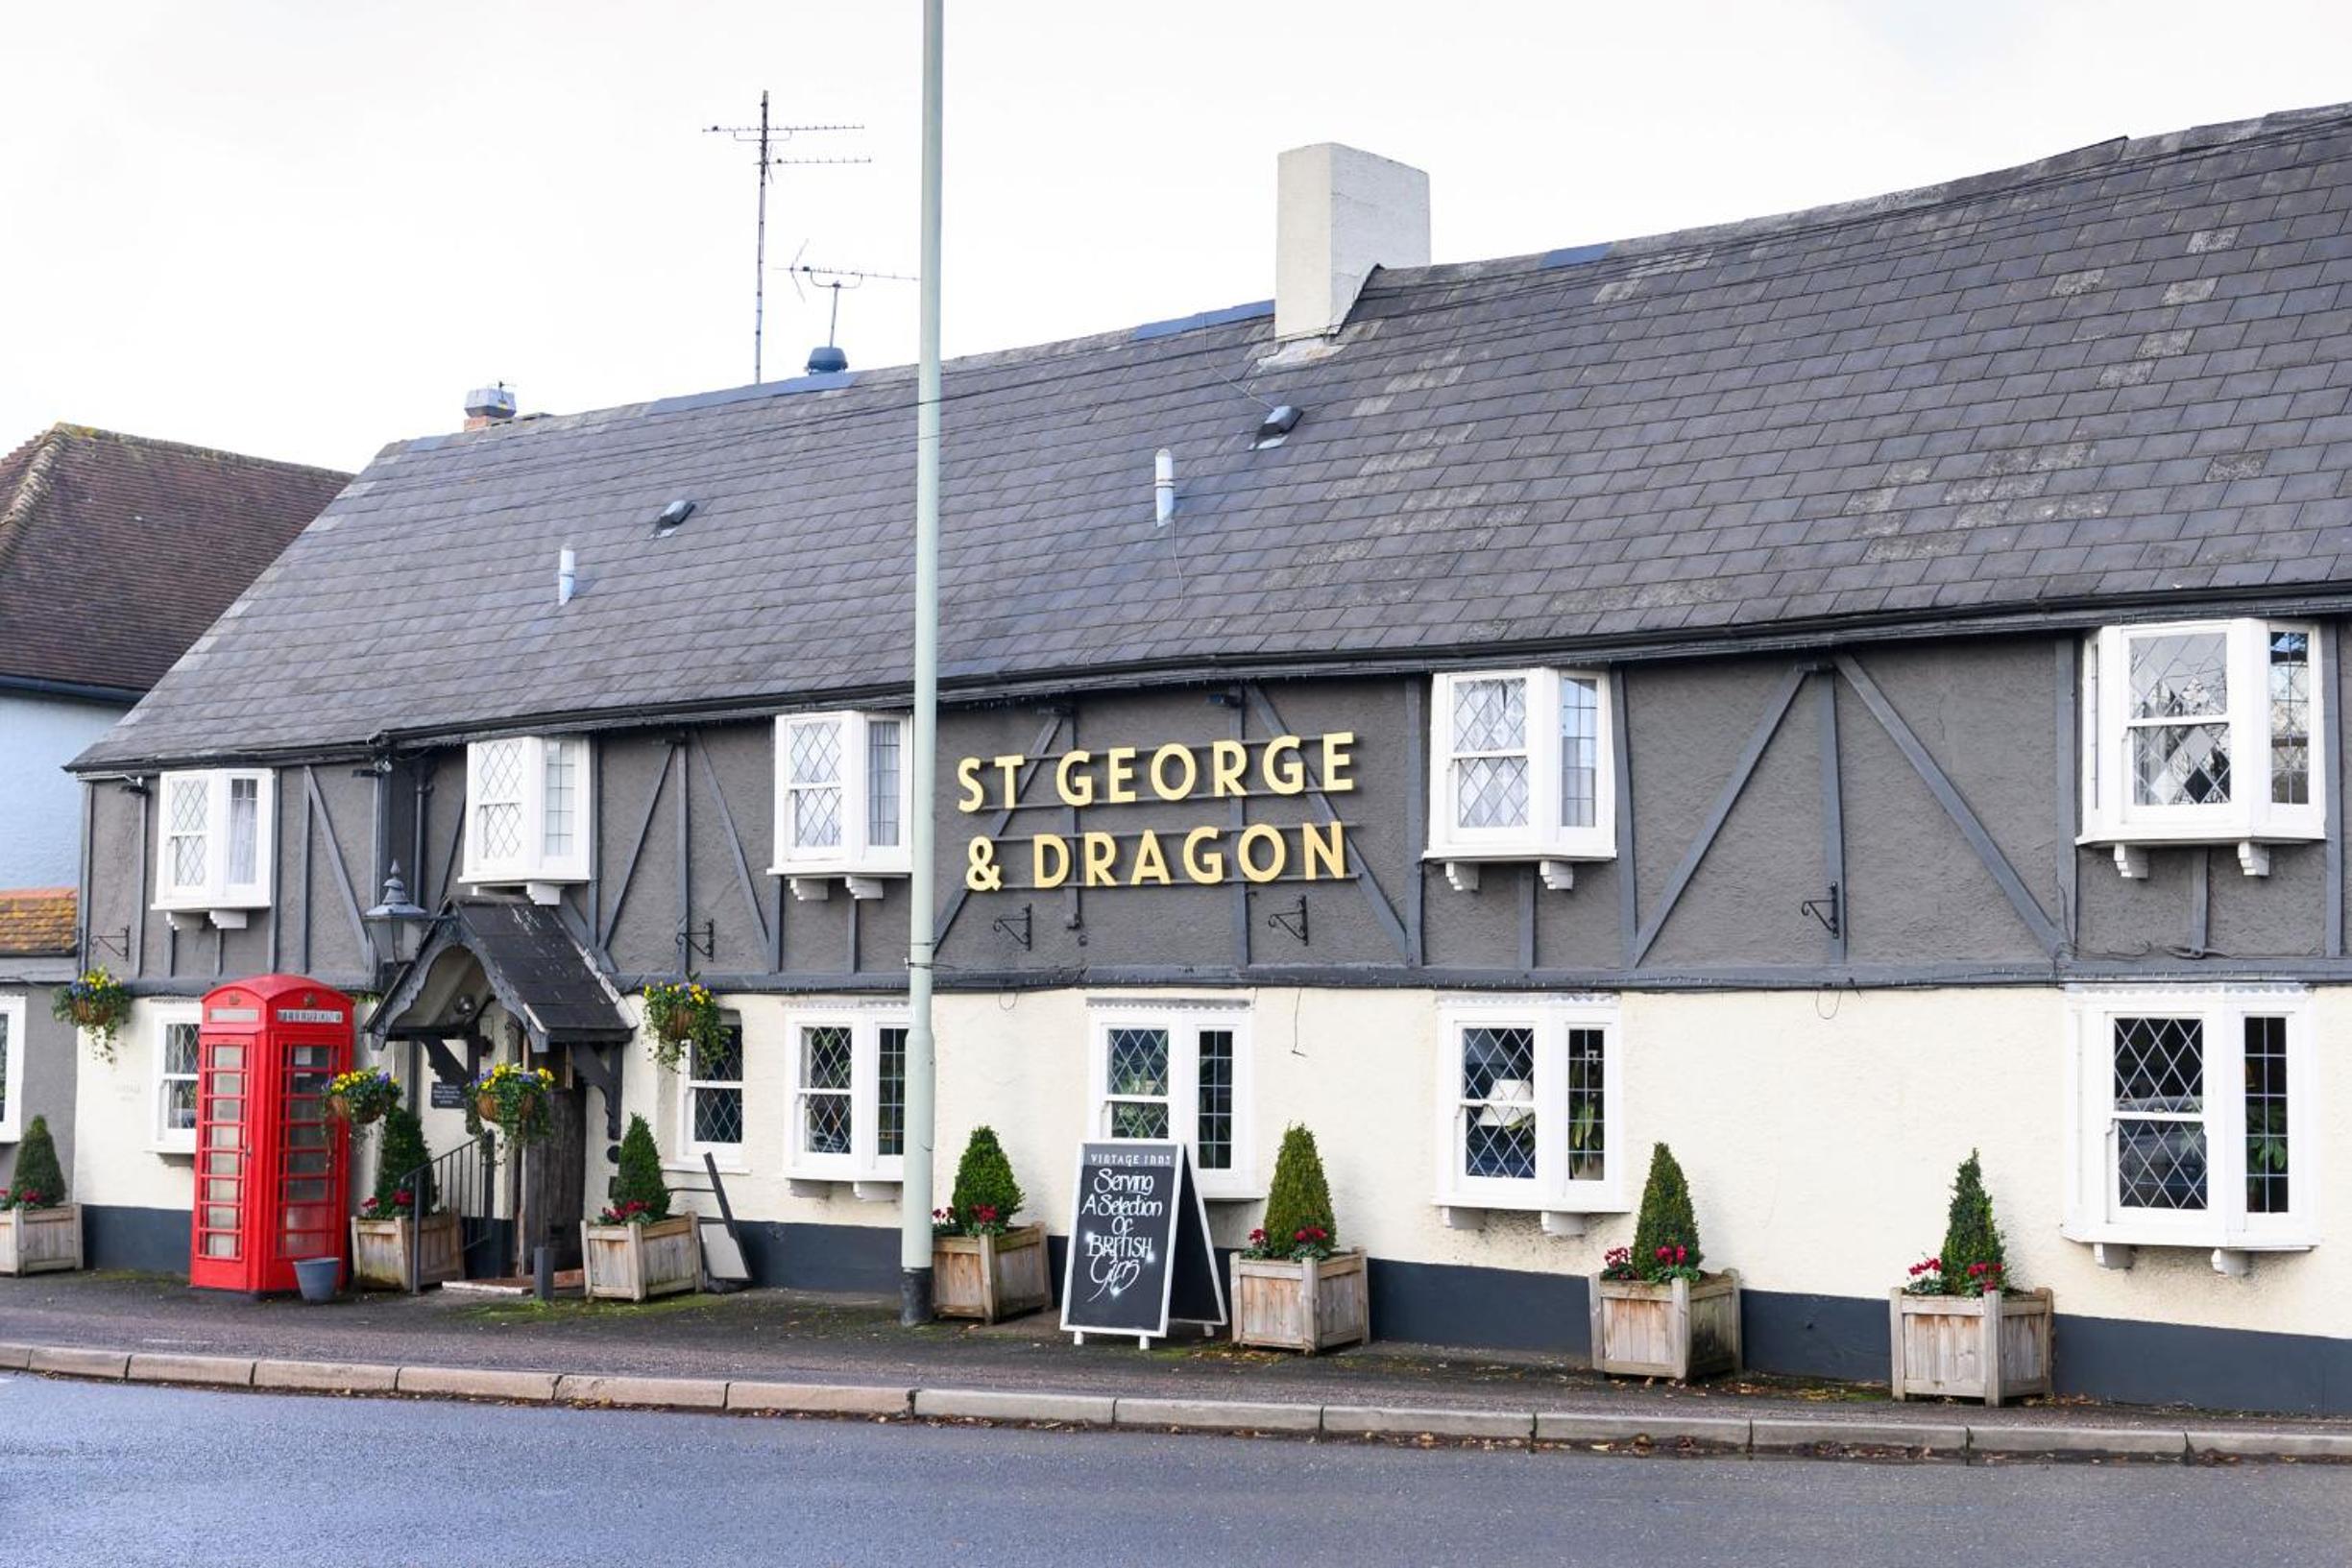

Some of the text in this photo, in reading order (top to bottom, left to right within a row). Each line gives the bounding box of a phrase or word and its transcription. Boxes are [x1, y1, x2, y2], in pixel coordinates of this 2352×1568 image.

[958, 732, 1354, 813] ST GEORGE
[965, 821, 1346, 892] & DRAGON
[1081, 1194, 1163, 1217] A Selection
[1094, 1168, 1154, 1195] Serving
